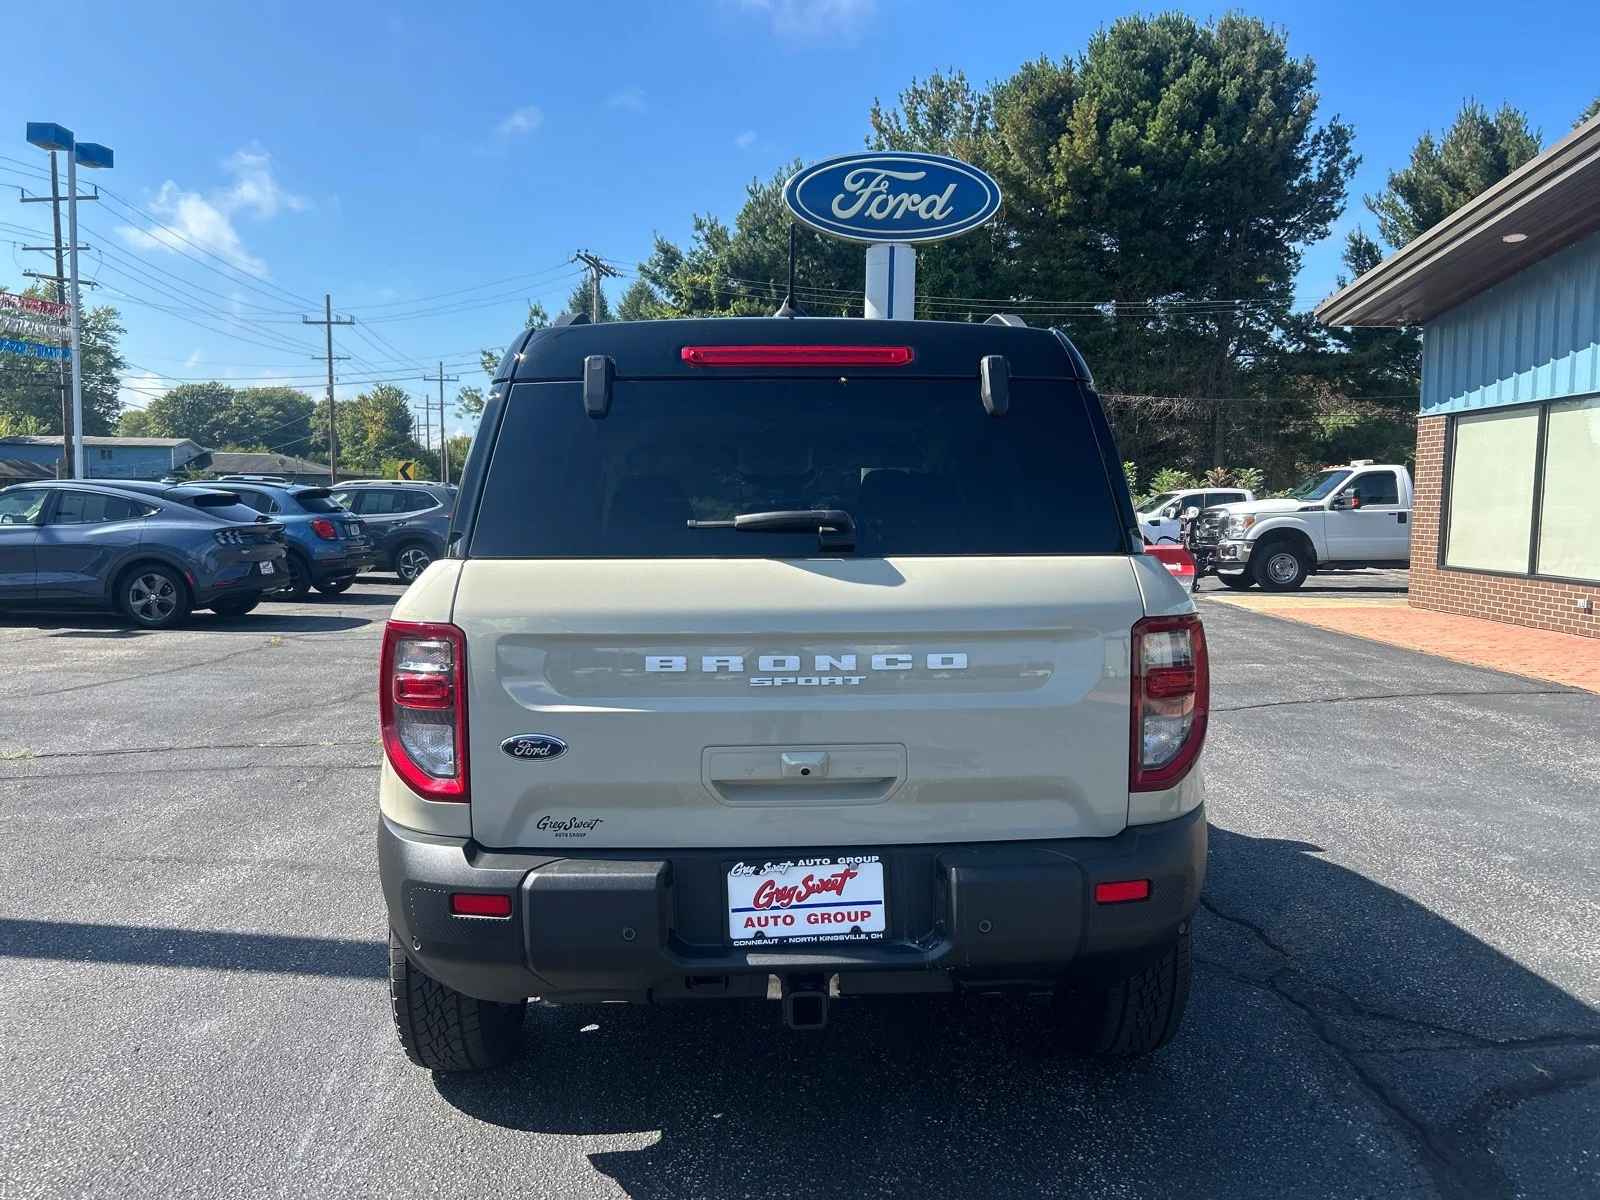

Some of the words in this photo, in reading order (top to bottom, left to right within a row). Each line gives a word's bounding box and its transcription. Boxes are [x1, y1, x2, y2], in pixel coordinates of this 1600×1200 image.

[832, 168, 957, 220] Ford
[645, 653, 967, 672] BRONCO
[750, 676, 866, 686] SPORT
[514, 739, 551, 756] Ford
[536, 815, 566, 832] Greg
[563, 816, 604, 831] Sweet
[760, 861, 794, 875] Sweet
[797, 858, 831, 866] AUTO
[838, 855, 880, 864] GROUP
[753, 880, 799, 909] Greg
[796, 868, 858, 902] Sweet
[743, 914, 796, 928] AUTO
[806, 910, 872, 925] GROUP
[733, 938, 779, 946] CONNEAUT
